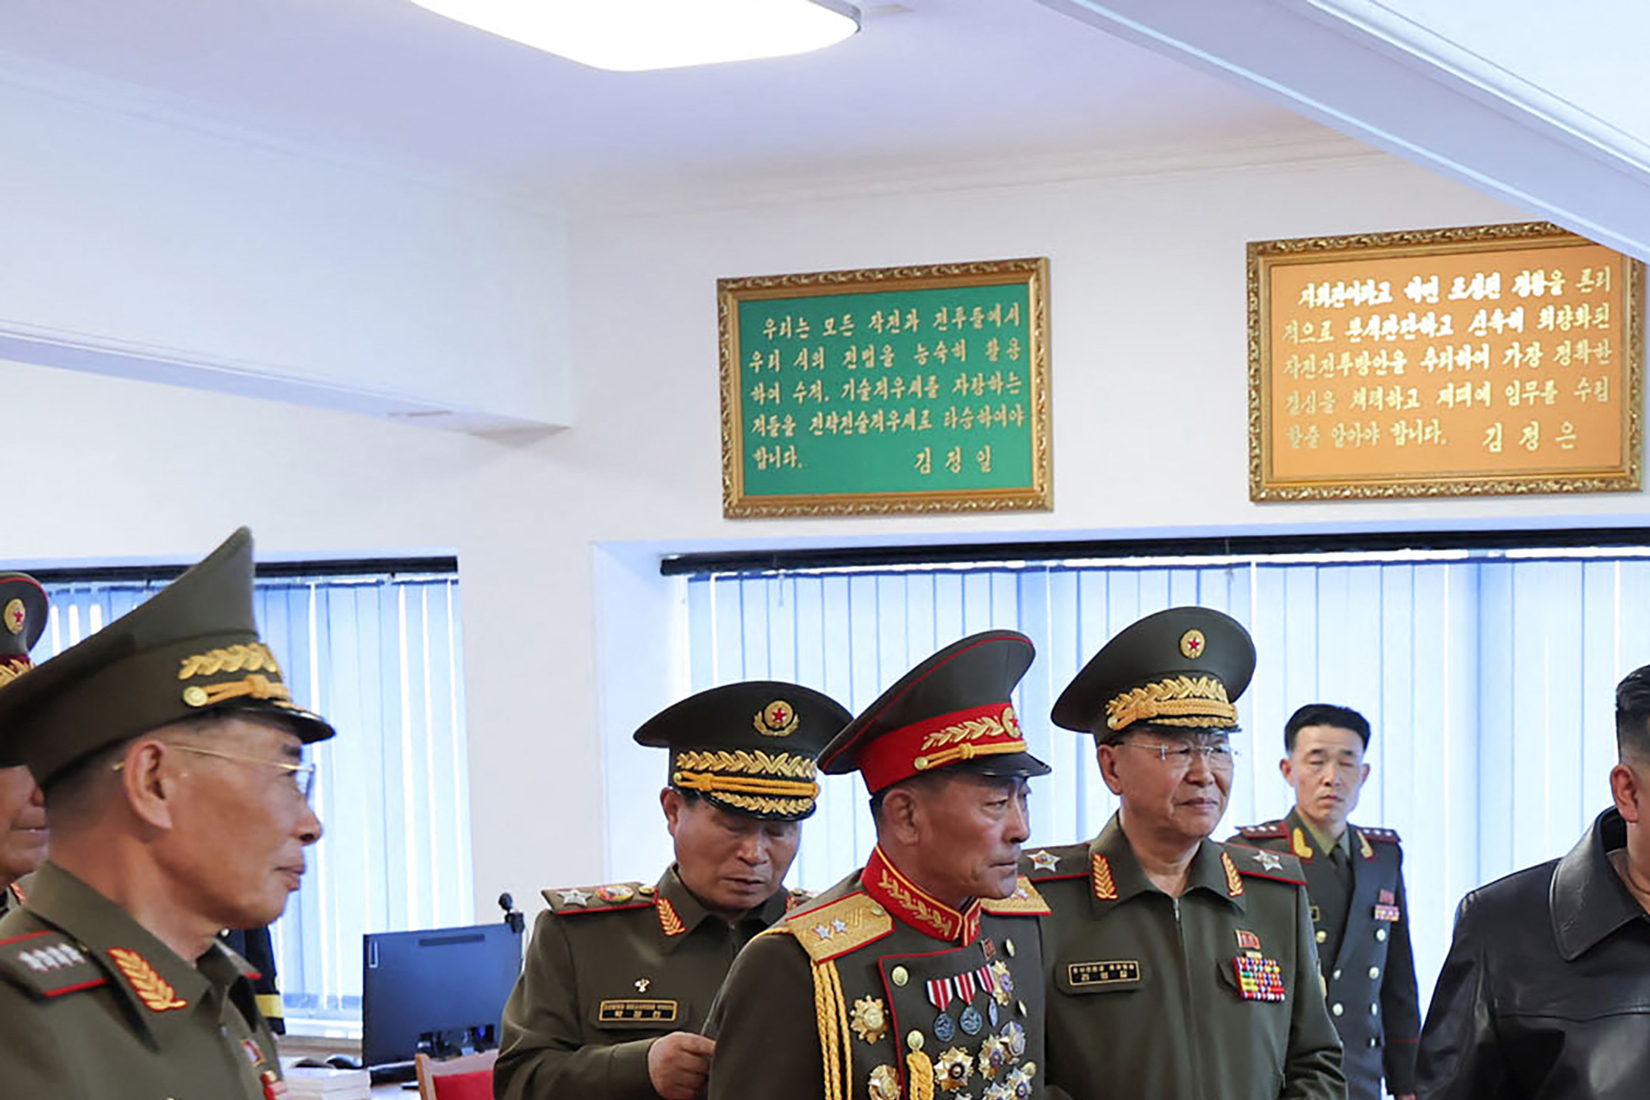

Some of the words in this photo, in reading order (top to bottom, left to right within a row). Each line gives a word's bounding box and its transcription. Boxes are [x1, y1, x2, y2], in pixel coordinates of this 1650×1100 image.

[1403, 275, 1440, 304] 하면
[762, 315, 810, 340] 우리는
[822, 314, 855, 336] 모든
[868, 310, 920, 334] 작전과
[933, 302, 1020, 331] 전투들에서
[1282, 319, 1335, 344] 적으로
[1344, 311, 1455, 343] 분석판단하고
[1468, 306, 1524, 337] 신속히
[749, 349, 780, 373] 우리
[843, 344, 895, 368] 전법을
[913, 338, 966, 365] 능숙히
[1282, 349, 1407, 380] 작전전투방안을
[1502, 341, 1544, 369] 가장
[1553, 337, 1613, 366] 정확한
[750, 381, 780, 406] 하여
[951, 371, 1022, 397] 자랑하는
[1285, 390, 1337, 416] 결심을
[1505, 379, 1559, 407] 임무를
[751, 413, 797, 438] 적들을
[943, 403, 1025, 431] 타승하여야
[1331, 420, 1381, 449] 알아야
[1389, 417, 1448, 446] 합니다.
[752, 444, 803, 470] 합니다.
